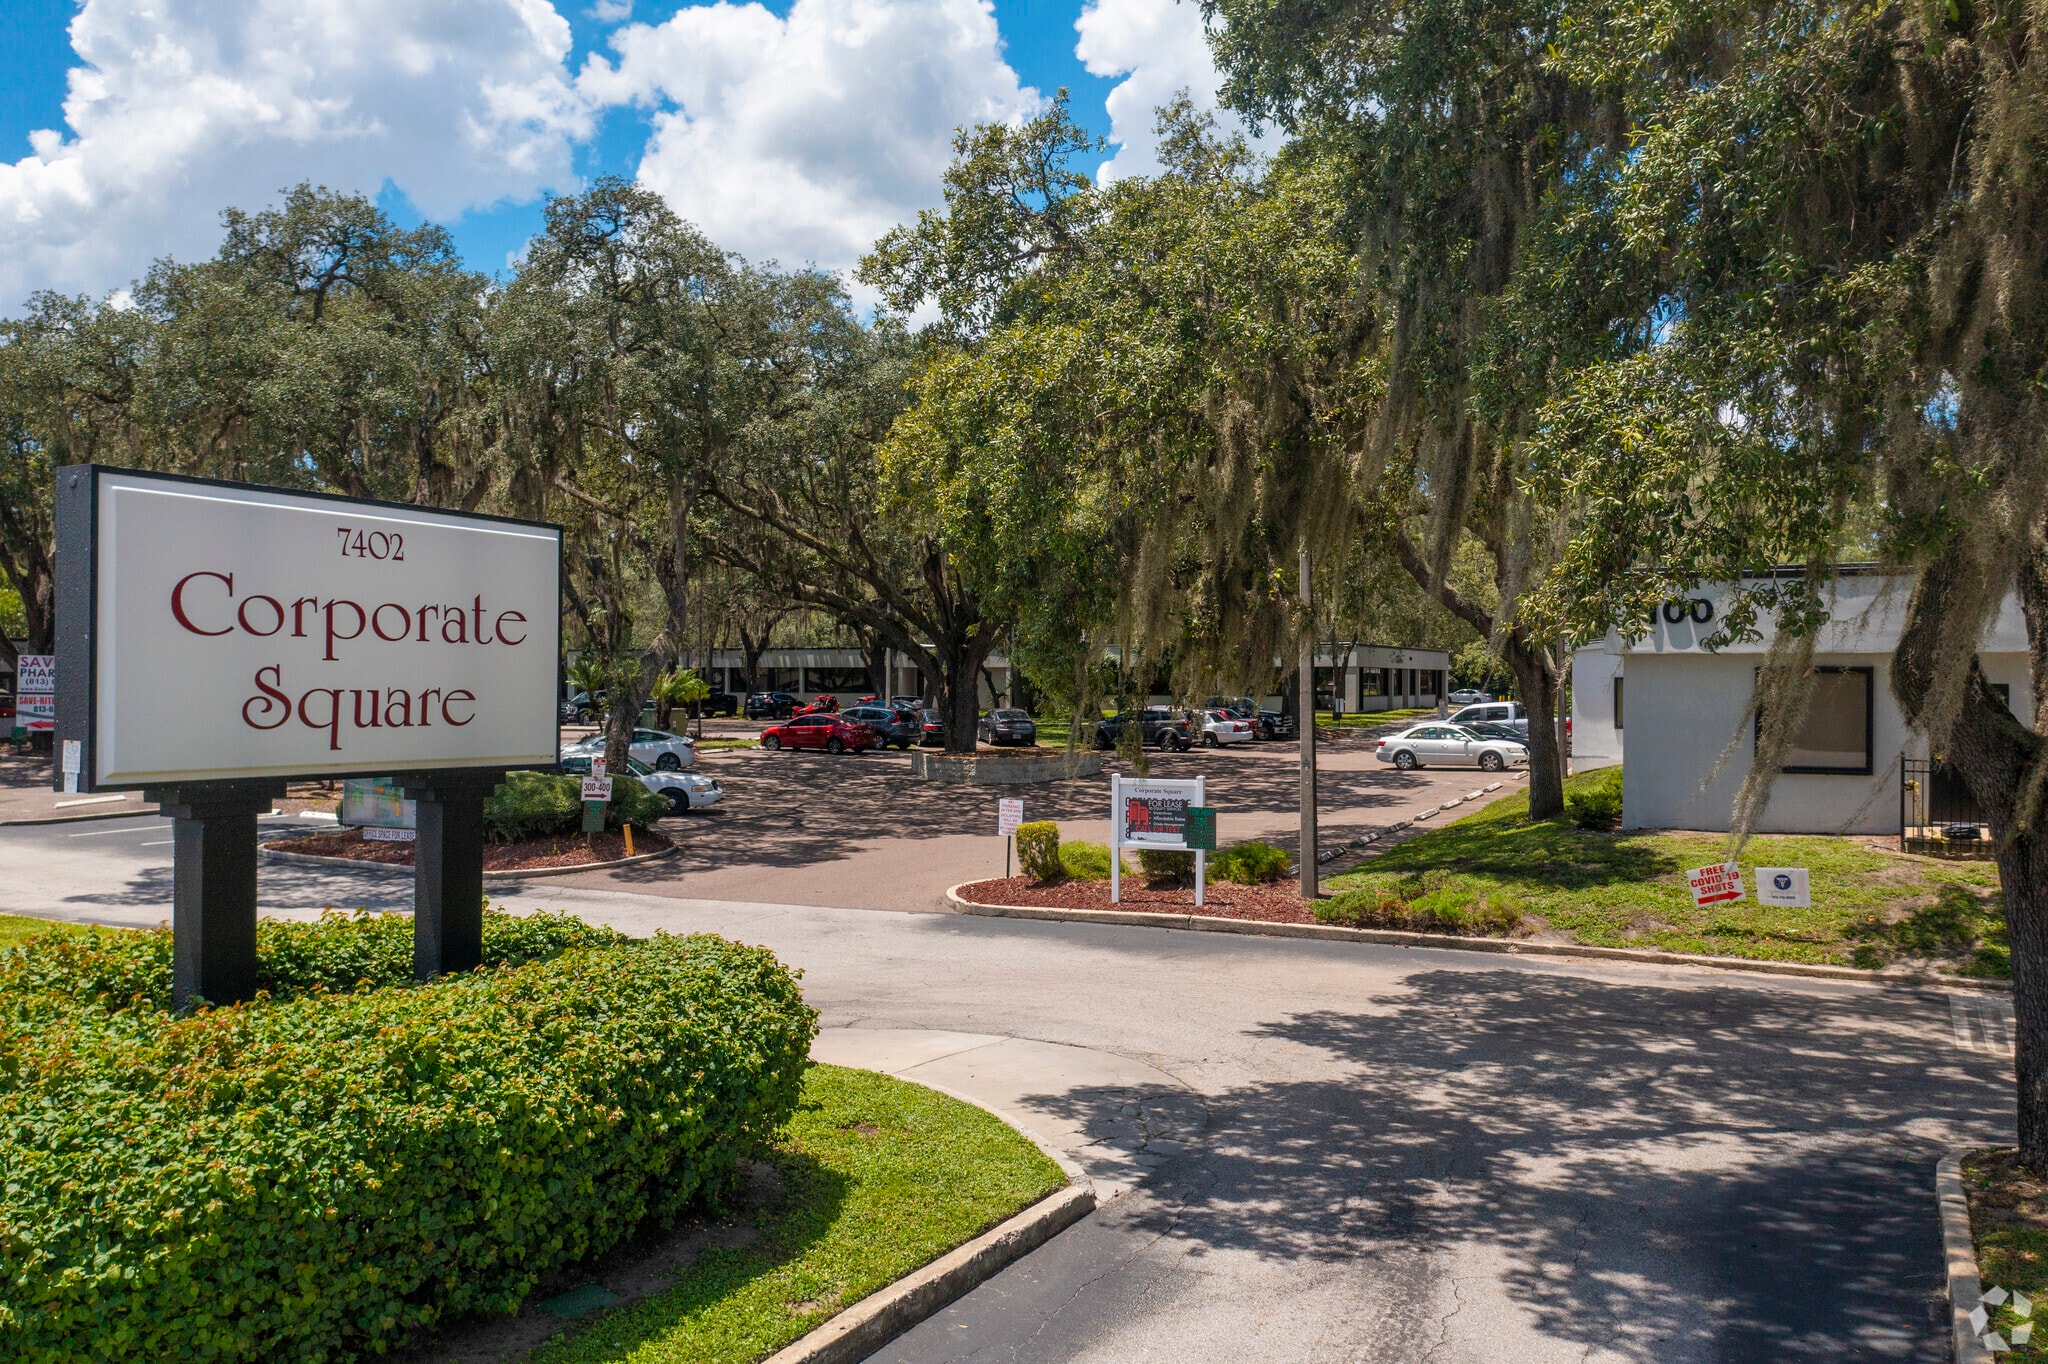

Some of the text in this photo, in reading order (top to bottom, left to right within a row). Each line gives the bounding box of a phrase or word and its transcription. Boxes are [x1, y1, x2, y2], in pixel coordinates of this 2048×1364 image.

[337, 527, 404, 561] 7402
[171, 571, 527, 661] Corporate
[25, 678, 49, 686] (813)
[242, 664, 477, 751] Square
[583, 782, 611, 792] 300-400
[1148, 800, 1163, 808] FOR
[1164, 800, 1183, 808] LEASE
[1699, 864, 1725, 877] FREE
[1690, 871, 1740, 888] COVID19
[1700, 881, 1735, 895] SHOTS
